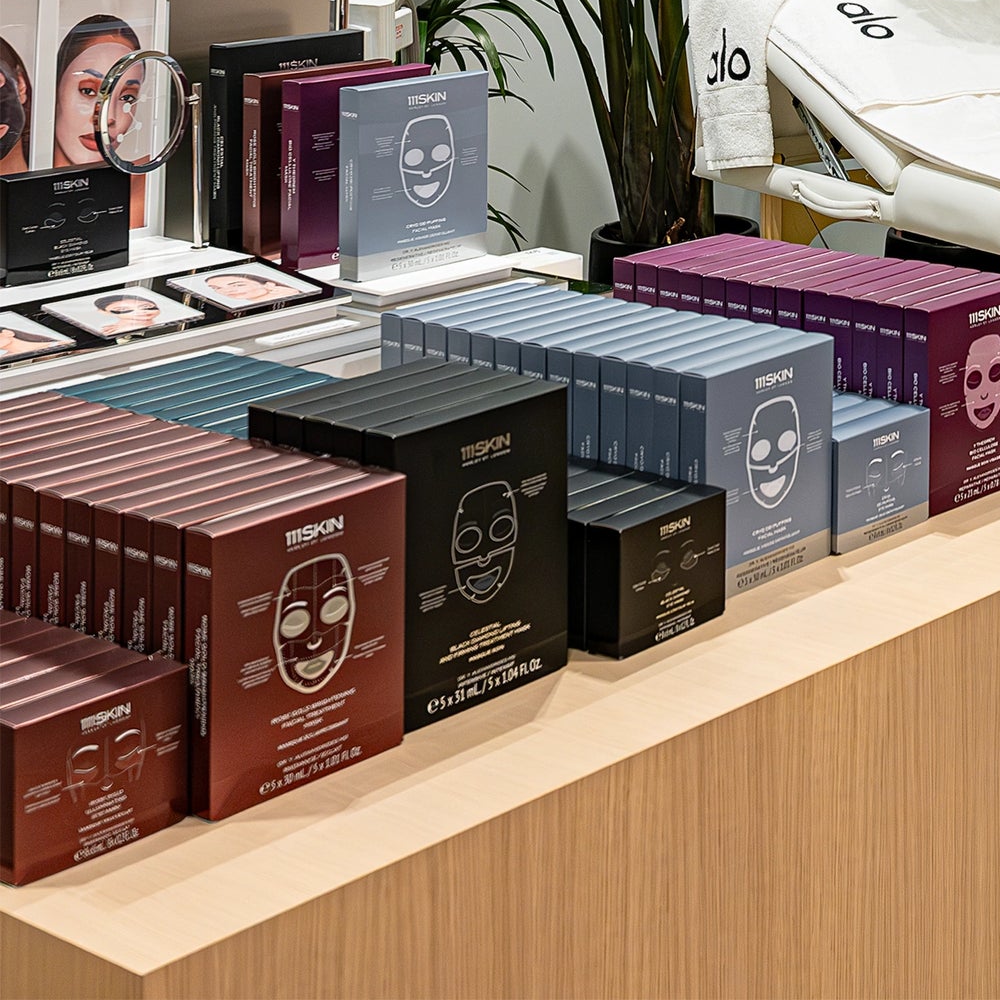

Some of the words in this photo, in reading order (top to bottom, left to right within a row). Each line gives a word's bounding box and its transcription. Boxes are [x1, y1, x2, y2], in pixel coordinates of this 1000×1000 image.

[836, 2, 898, 39] alo
[408, 91, 447, 106] 111SKIN
[52, 178, 90, 191] 111SKIN
[754, 366, 793, 391] 111SKIN
[460, 432, 511, 461] 111SKIN
[872, 431, 900, 447] 111SKIN
[285, 514, 344, 547] 111SKIN
[660, 516, 691, 536] 111SKIN
[80, 702, 131, 731] 111SKIN
